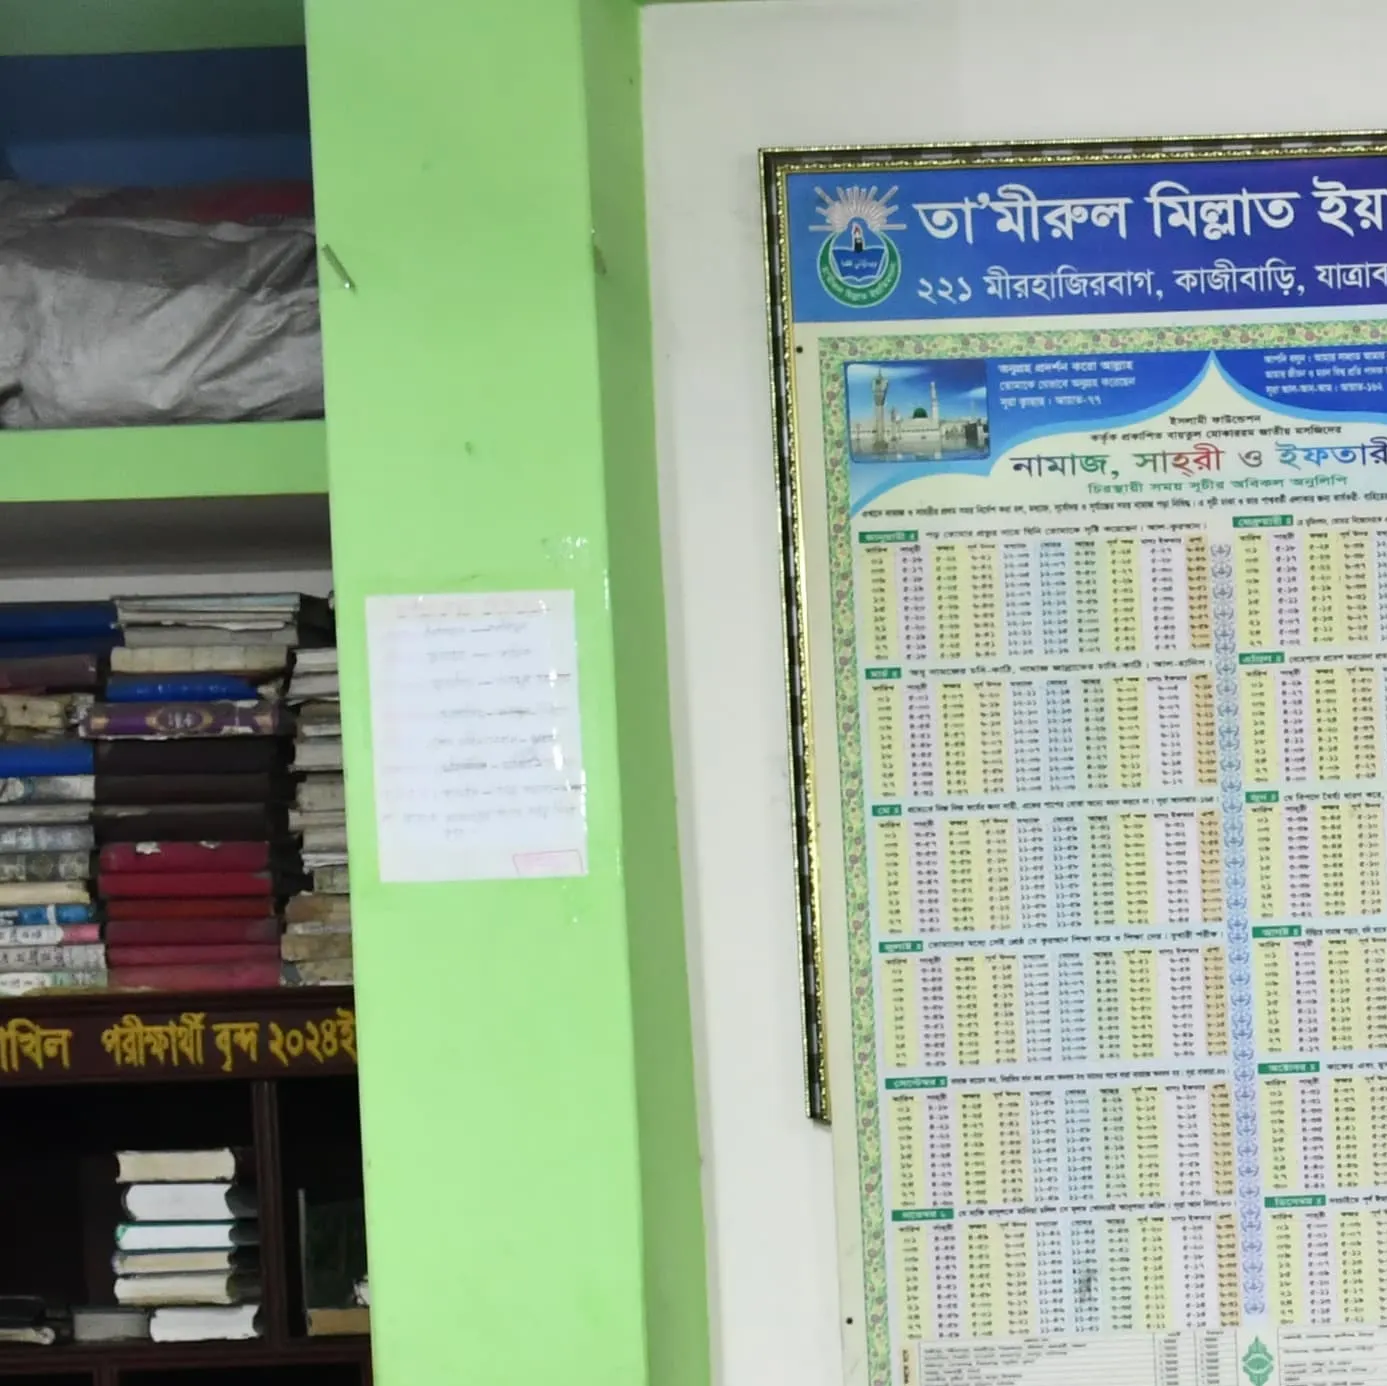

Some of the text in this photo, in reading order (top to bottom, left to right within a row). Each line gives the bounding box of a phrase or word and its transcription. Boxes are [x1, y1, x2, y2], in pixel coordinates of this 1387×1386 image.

[912, 184, 1128, 244] তা'মীরুল
[1147, 181, 1297, 240] মিল্লাত
[917, 276, 972, 304] ২২১
[982, 265, 1164, 302] মীরহাজিরবাগ,
[1168, 414, 1207, 425] ইসলামী
[1009, 453, 1119, 480] নামাজ,
[1238, 449, 1263, 469] ও
